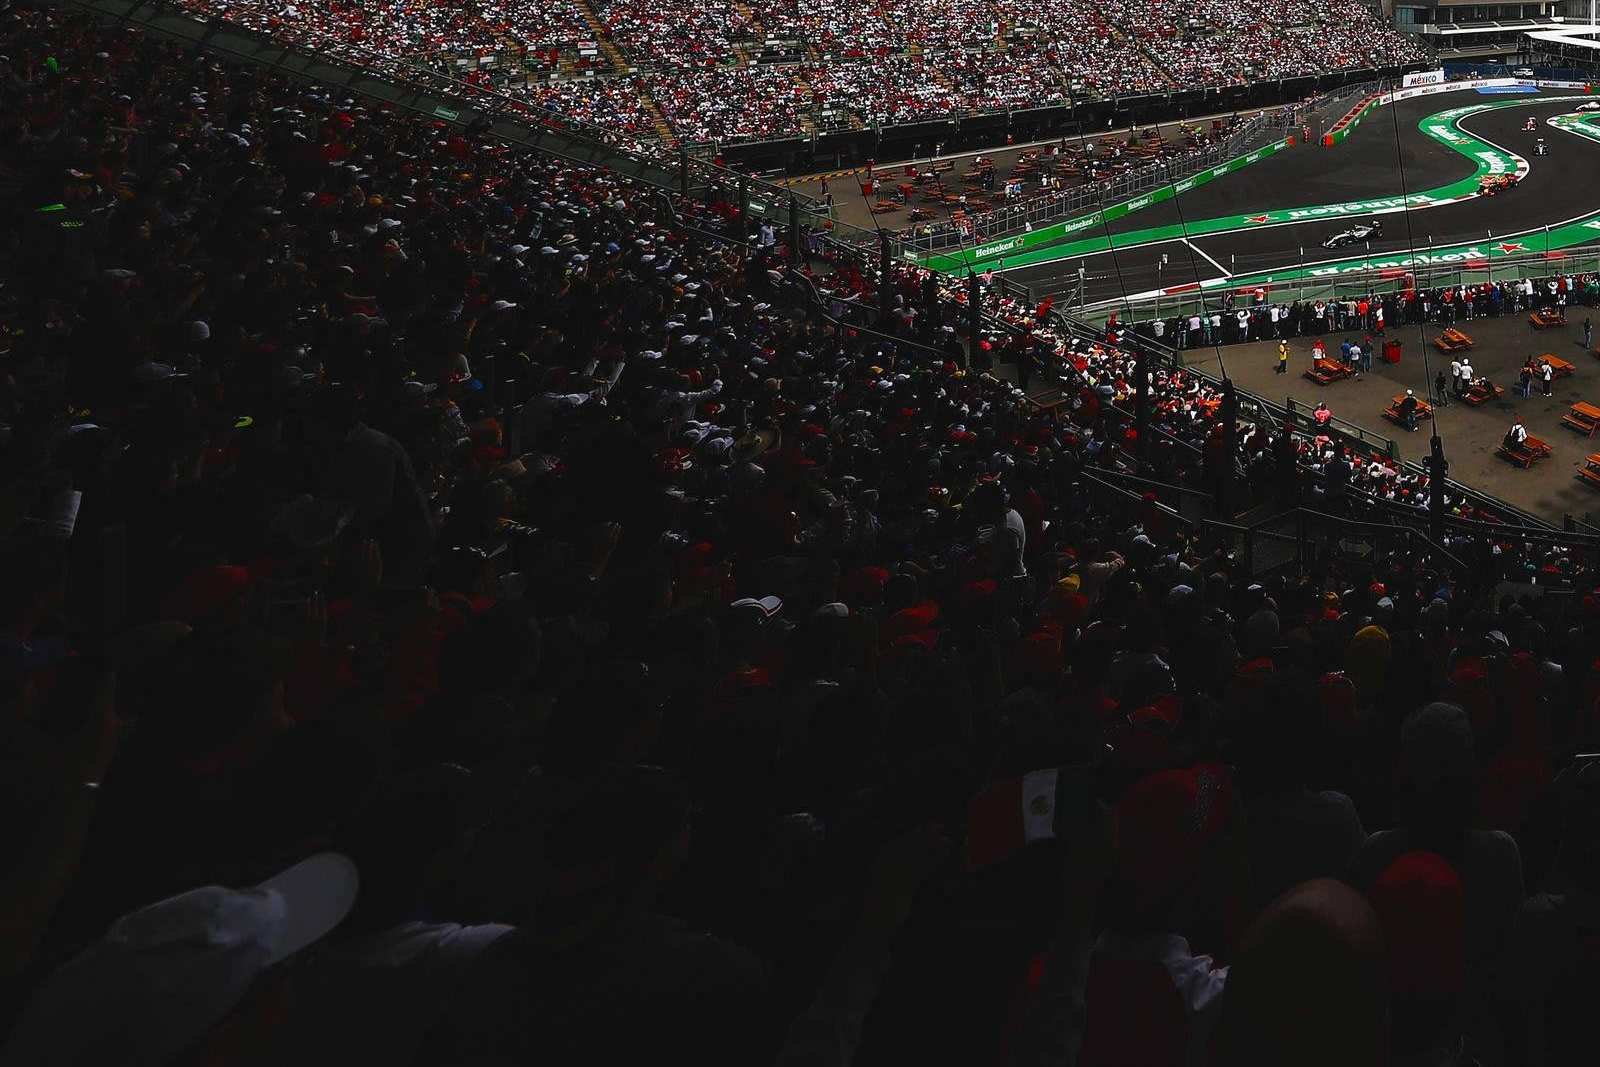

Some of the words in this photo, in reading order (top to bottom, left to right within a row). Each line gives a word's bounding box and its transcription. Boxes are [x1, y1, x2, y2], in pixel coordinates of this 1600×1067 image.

[1288, 194, 1437, 220] Heineken
[1065, 217, 1094, 233] Heineken
[975, 242, 1015, 258] Heineken
